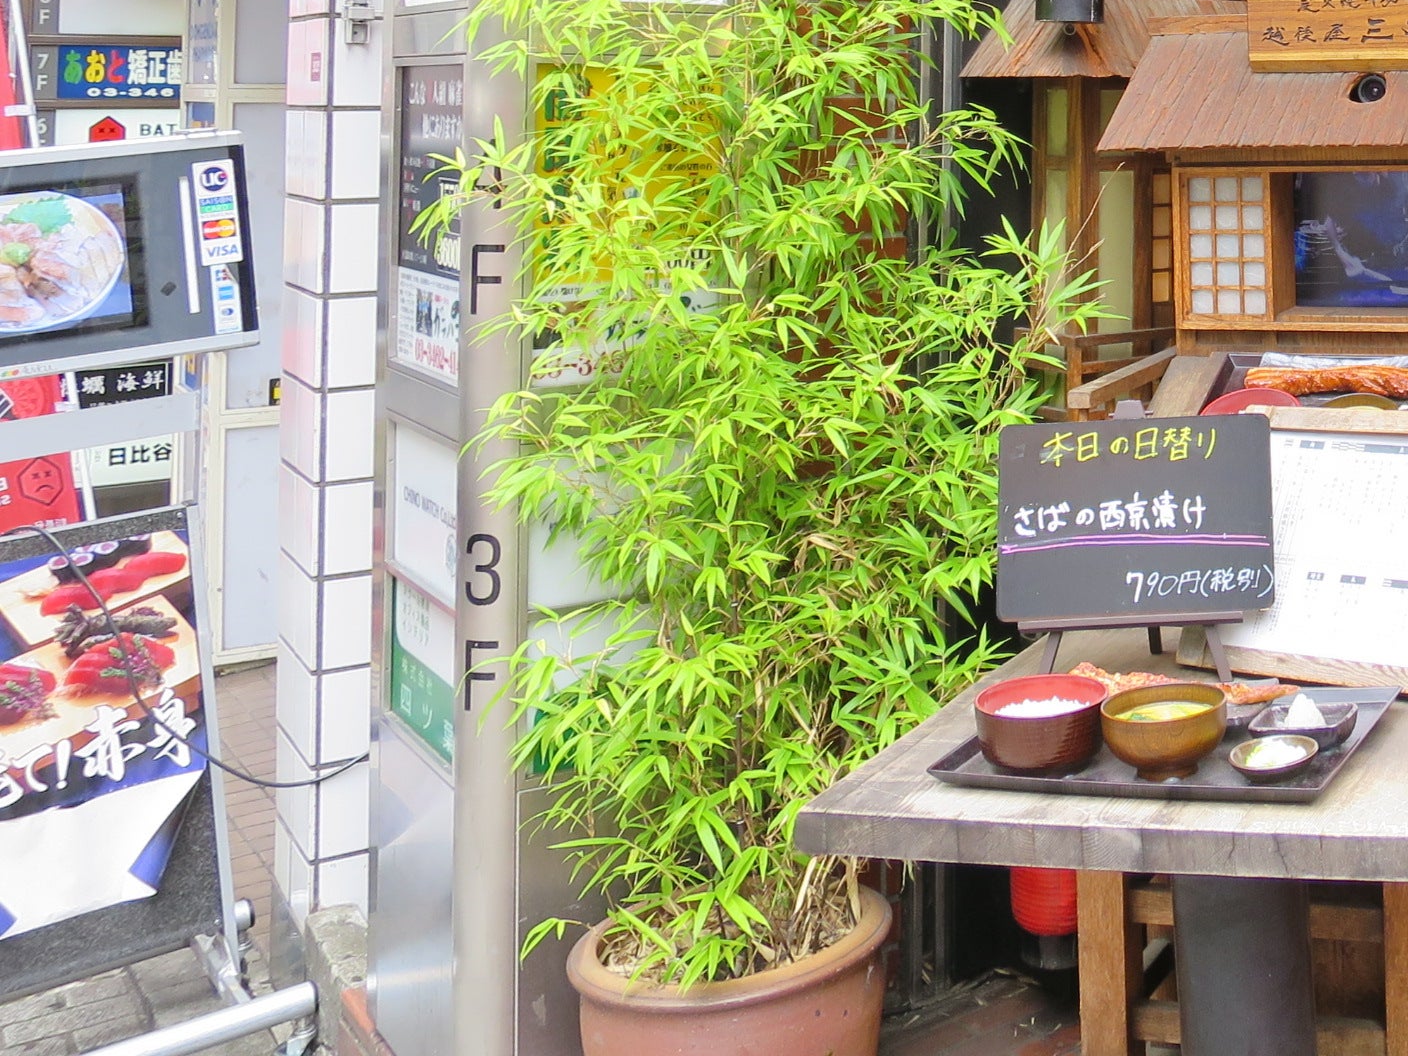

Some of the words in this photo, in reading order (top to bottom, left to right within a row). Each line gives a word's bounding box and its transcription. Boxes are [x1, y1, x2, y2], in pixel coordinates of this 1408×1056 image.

[36, 53, 49, 92] 7F
[201, 172, 228, 188] UC
[206, 244, 239, 258] VISA
[117, 370, 164, 392] 海鮮
[109, 443, 172, 467] 日比谷
[1040, 426, 1217, 467] 本日の日替り
[1014, 490, 1207, 537] さばの西京漬け
[1126, 564, 1275, 604] 790円(税別)
